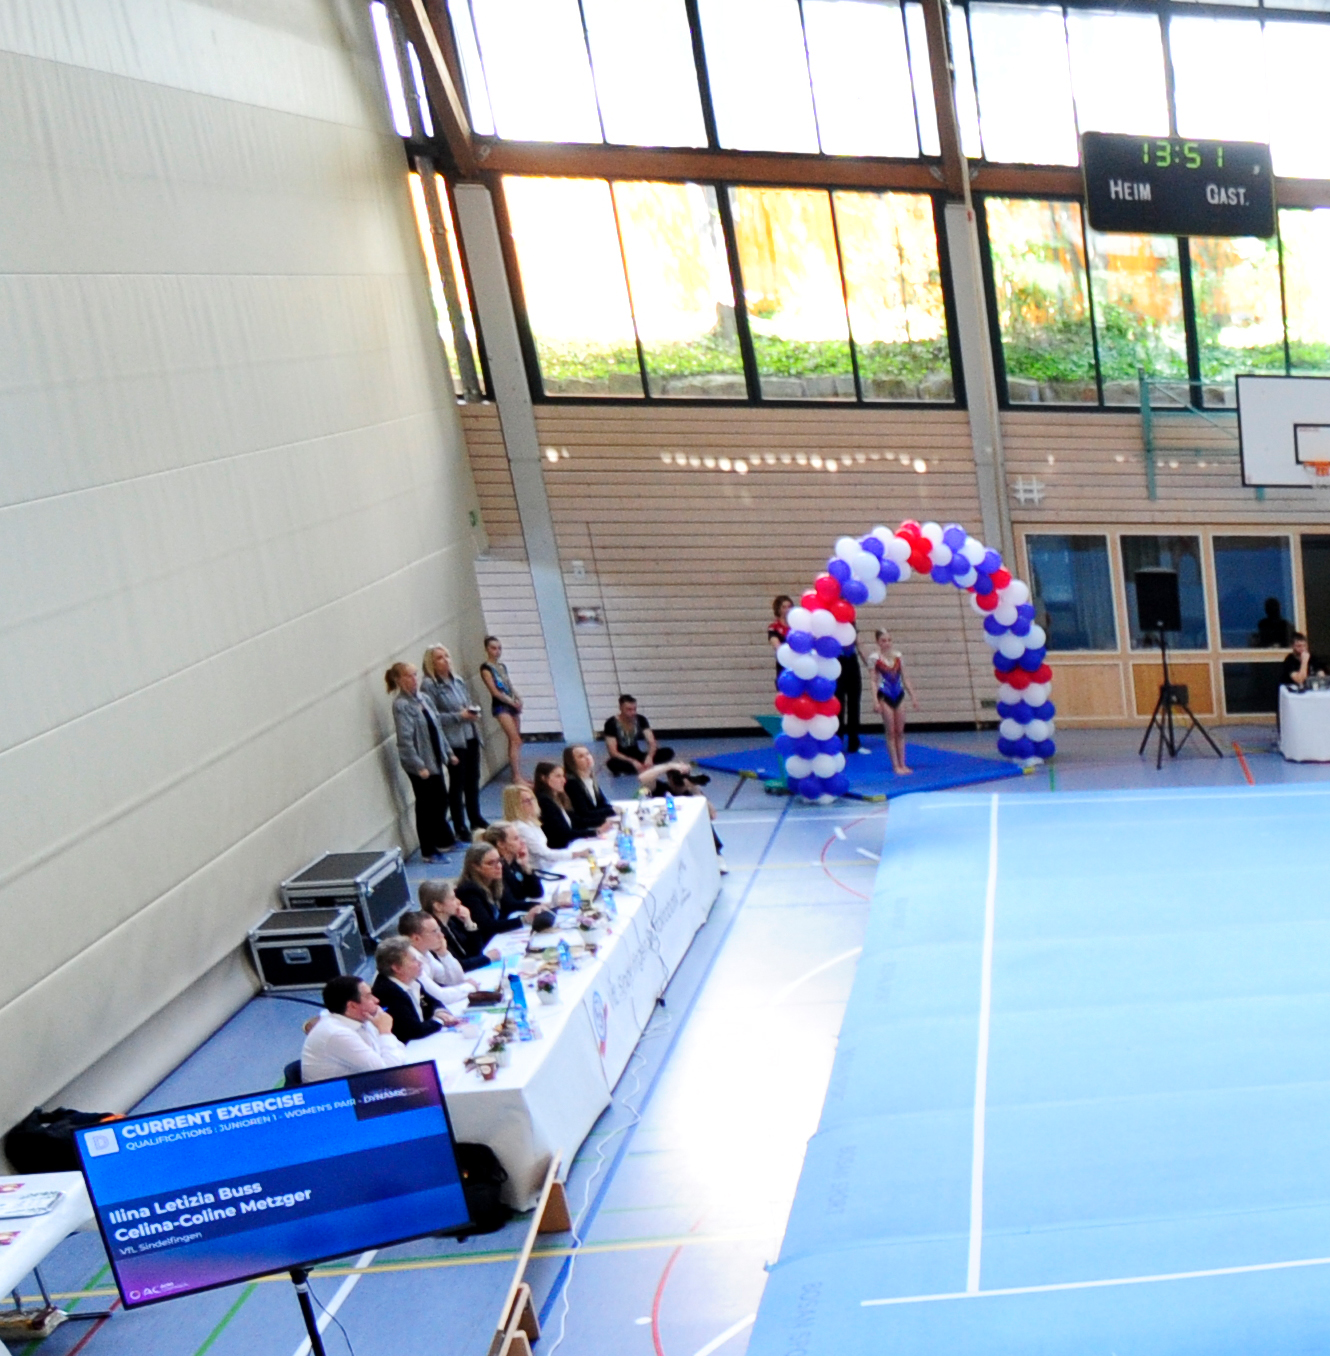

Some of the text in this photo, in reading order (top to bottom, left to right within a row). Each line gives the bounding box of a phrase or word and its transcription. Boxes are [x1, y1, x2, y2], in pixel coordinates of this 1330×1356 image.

[1141, 140, 1225, 168] 13:51
[122, 1092, 305, 1139] CURRENT EXERCISE
[125, 1126, 213, 1151] QUALIFICATIONS
[218, 1114, 272, 1133] JUNIOREN
[109, 1182, 262, 1225] Ilina Letizia Buss
[114, 1189, 312, 1242] Celina-Coline Metzger
[138, 1231, 203, 1252] Sindelfingen
